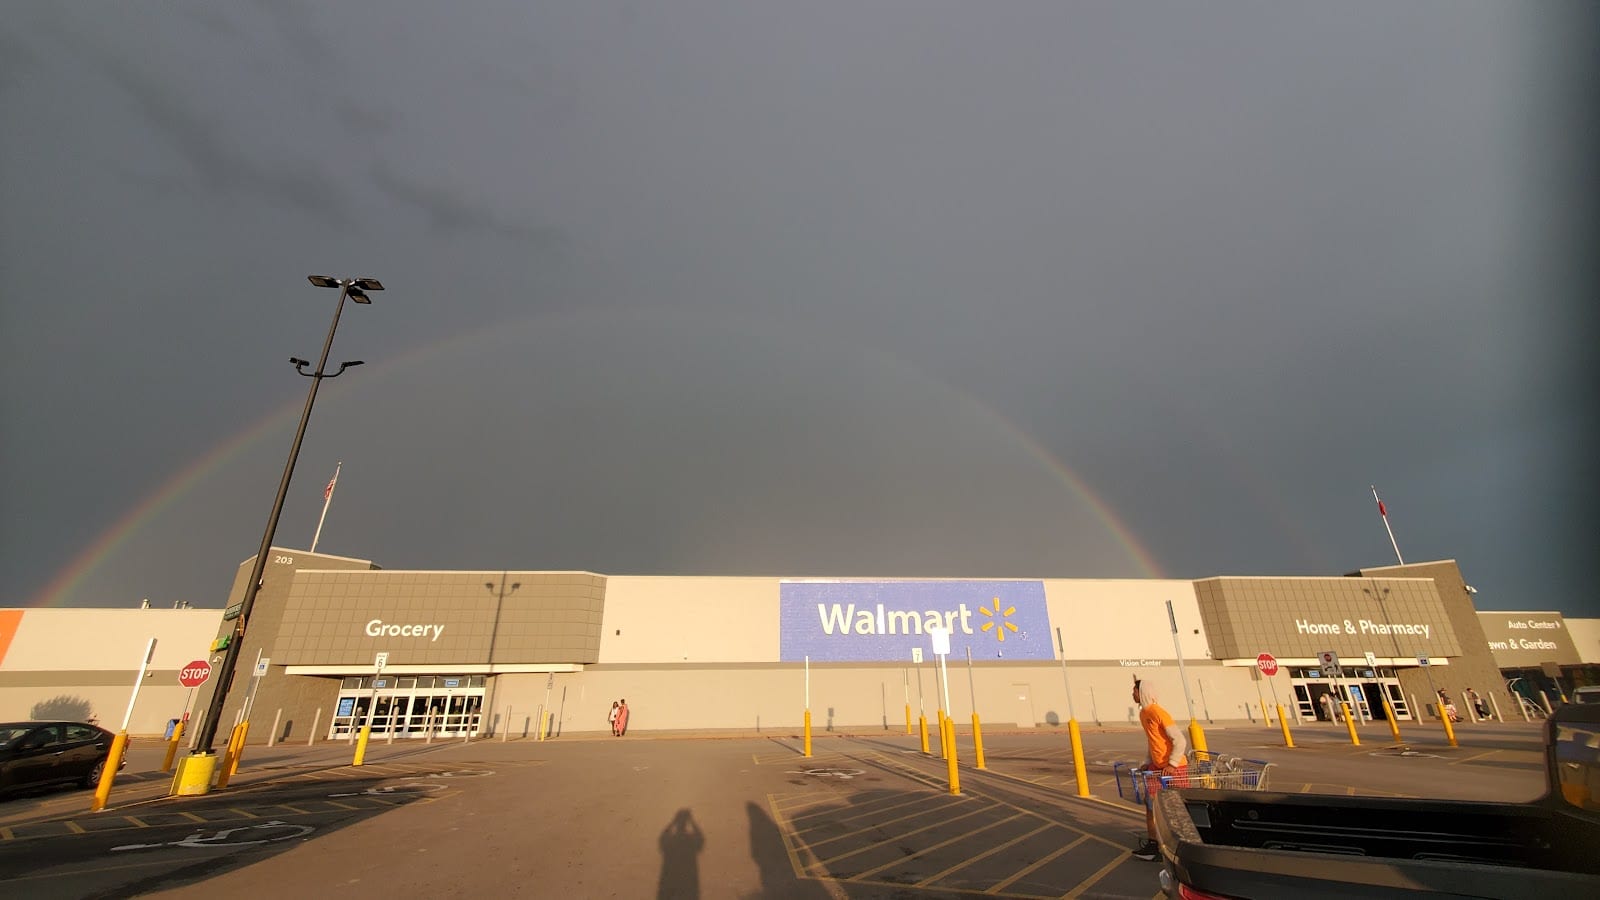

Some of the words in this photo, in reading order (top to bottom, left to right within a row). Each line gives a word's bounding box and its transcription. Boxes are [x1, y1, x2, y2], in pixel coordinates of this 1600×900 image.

[275, 556, 293, 565] 203
[818, 604, 974, 635] Walmart
[1508, 620, 1527, 629] Auto
[1528, 620, 1555, 629] Center
[366, 620, 445, 641] Grocery
[1296, 619, 1341, 634] Home
[1344, 620, 1357, 634] &
[1359, 620, 1430, 639] Pharmacy
[1509, 638, 1519, 650] &
[1520, 638, 1557, 650] Garden
[1120, 659, 1139, 667] Vision
[1140, 659, 1162, 667] Center
[1258, 660, 1276, 670] STOP
[181, 668, 209, 680] STOP
